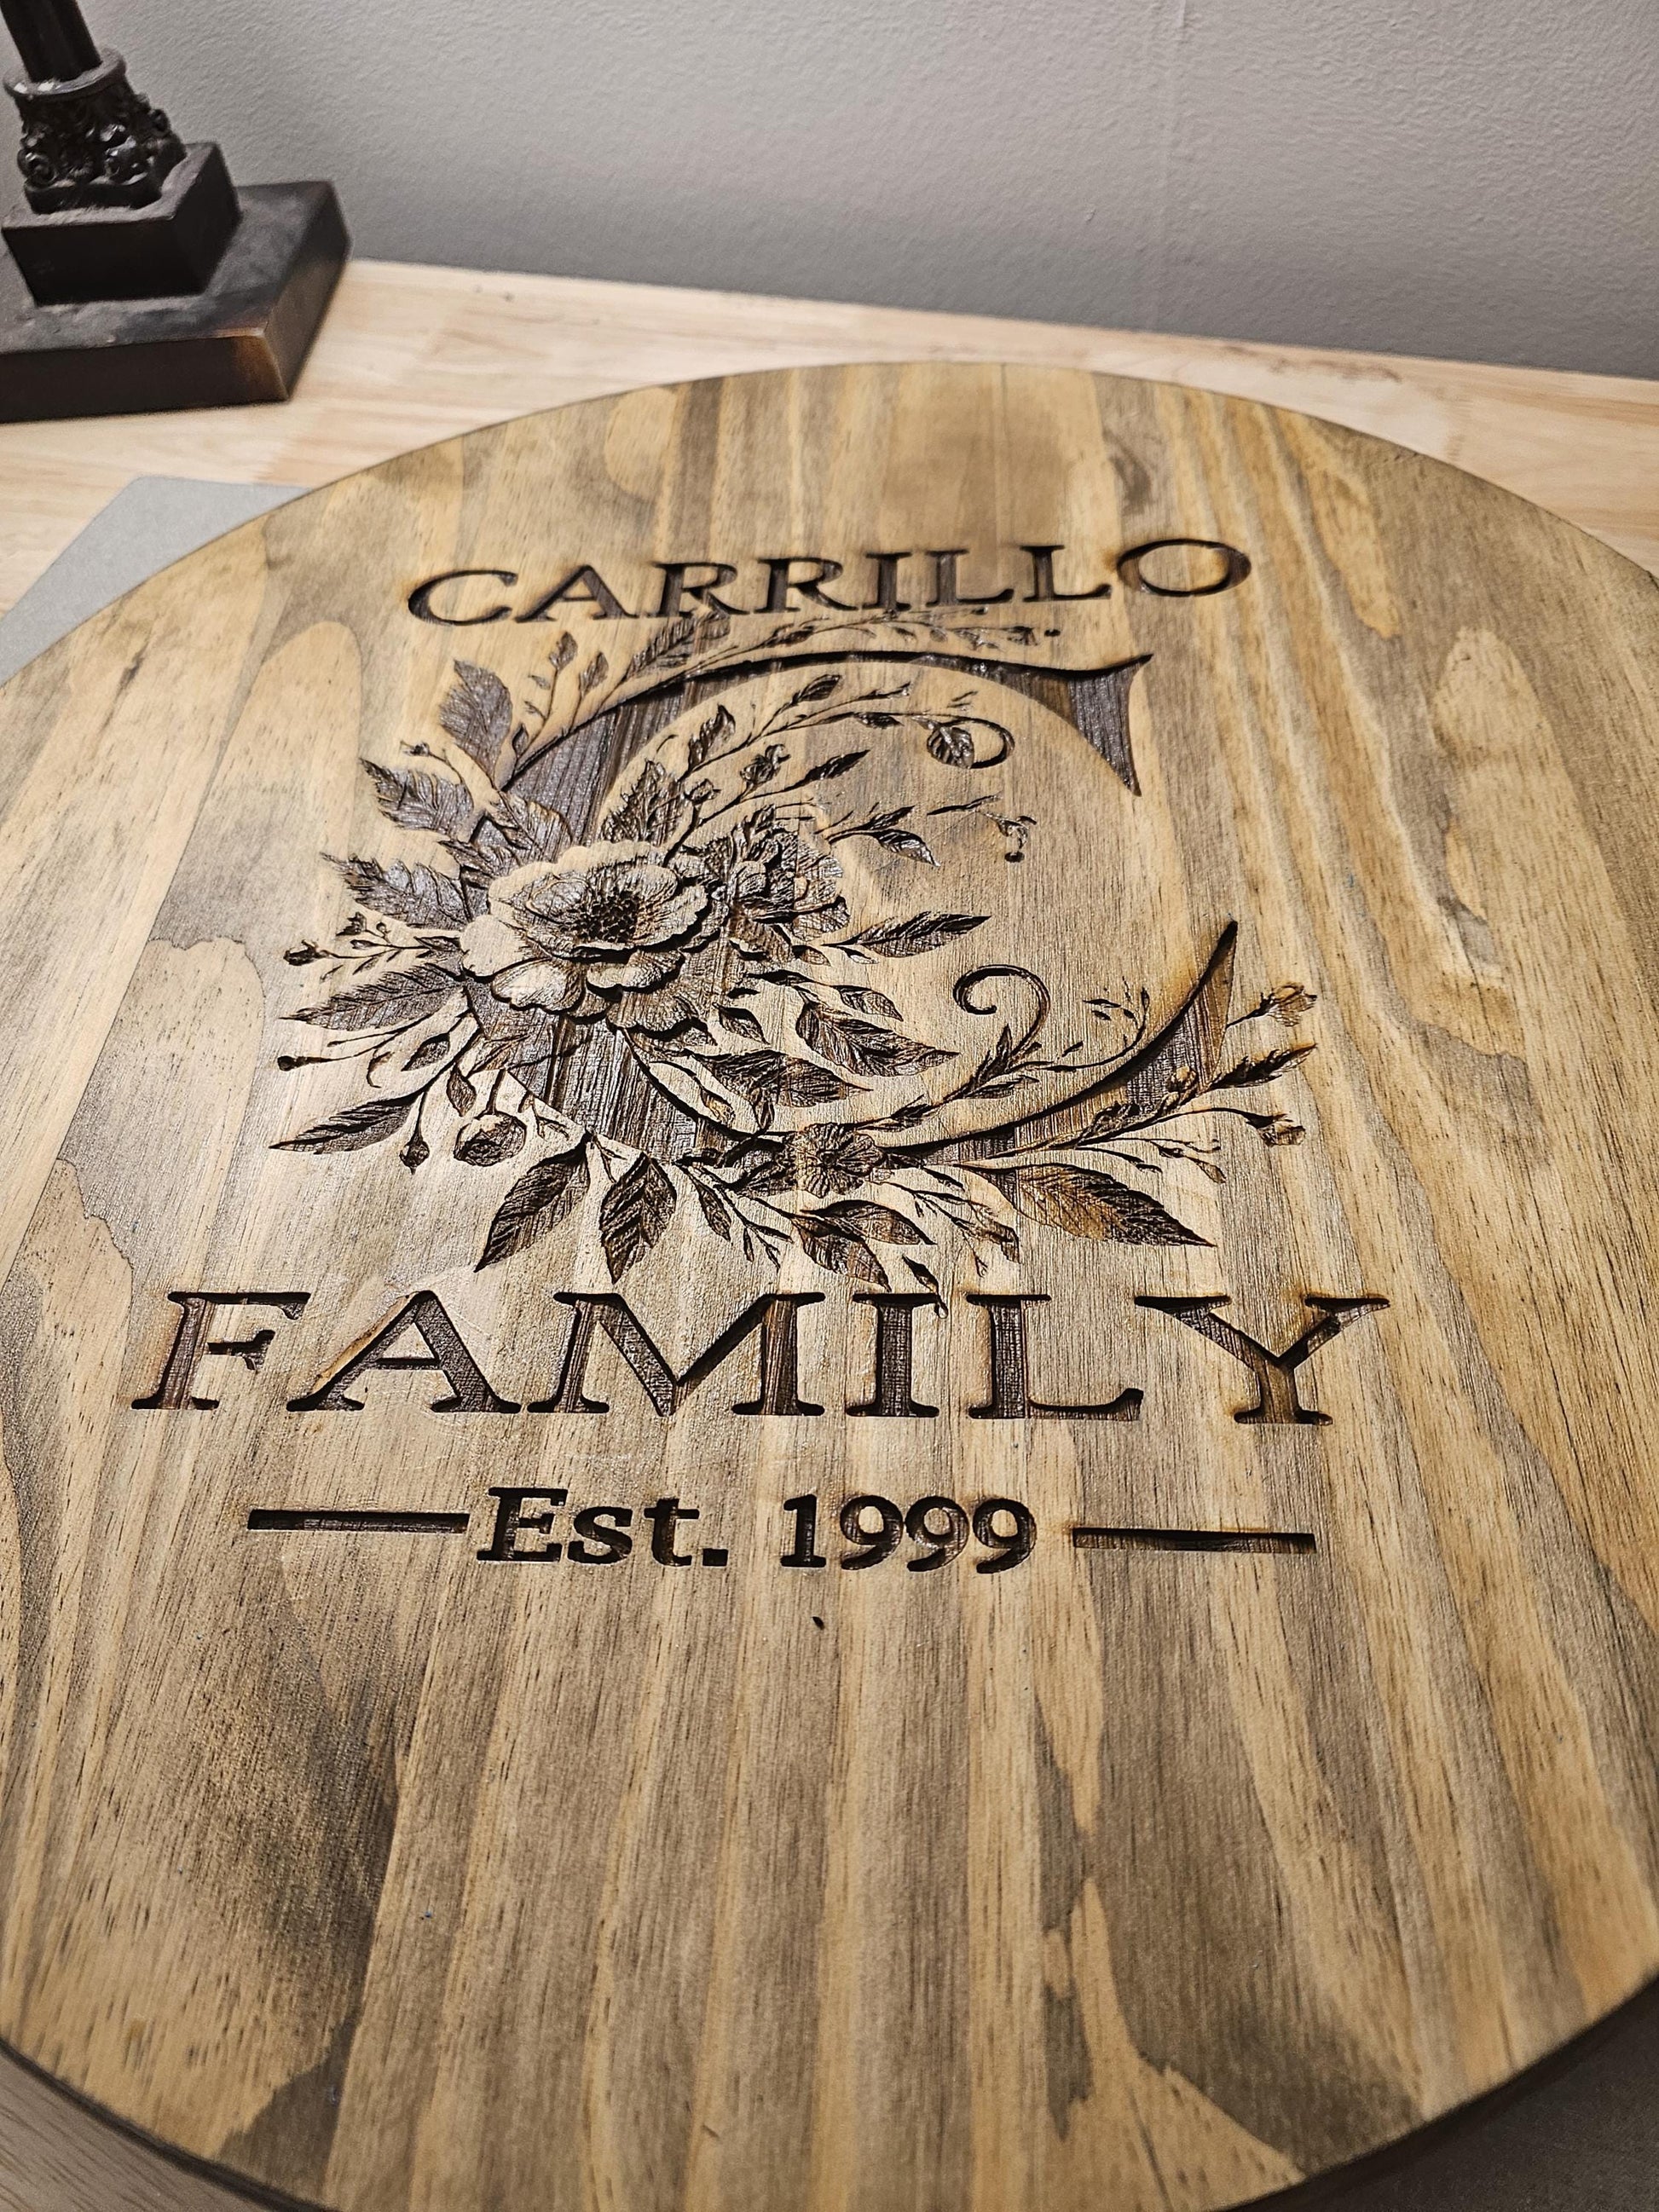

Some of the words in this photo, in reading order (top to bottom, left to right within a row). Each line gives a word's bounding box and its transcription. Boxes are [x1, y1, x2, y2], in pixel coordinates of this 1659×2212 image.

[408, 539, 1251, 626] CARRILLO
[132, 1290, 1390, 1425] FAMILY
[477, 1486, 729, 1566] Est.
[780, 1494, 1037, 1573] 1999
